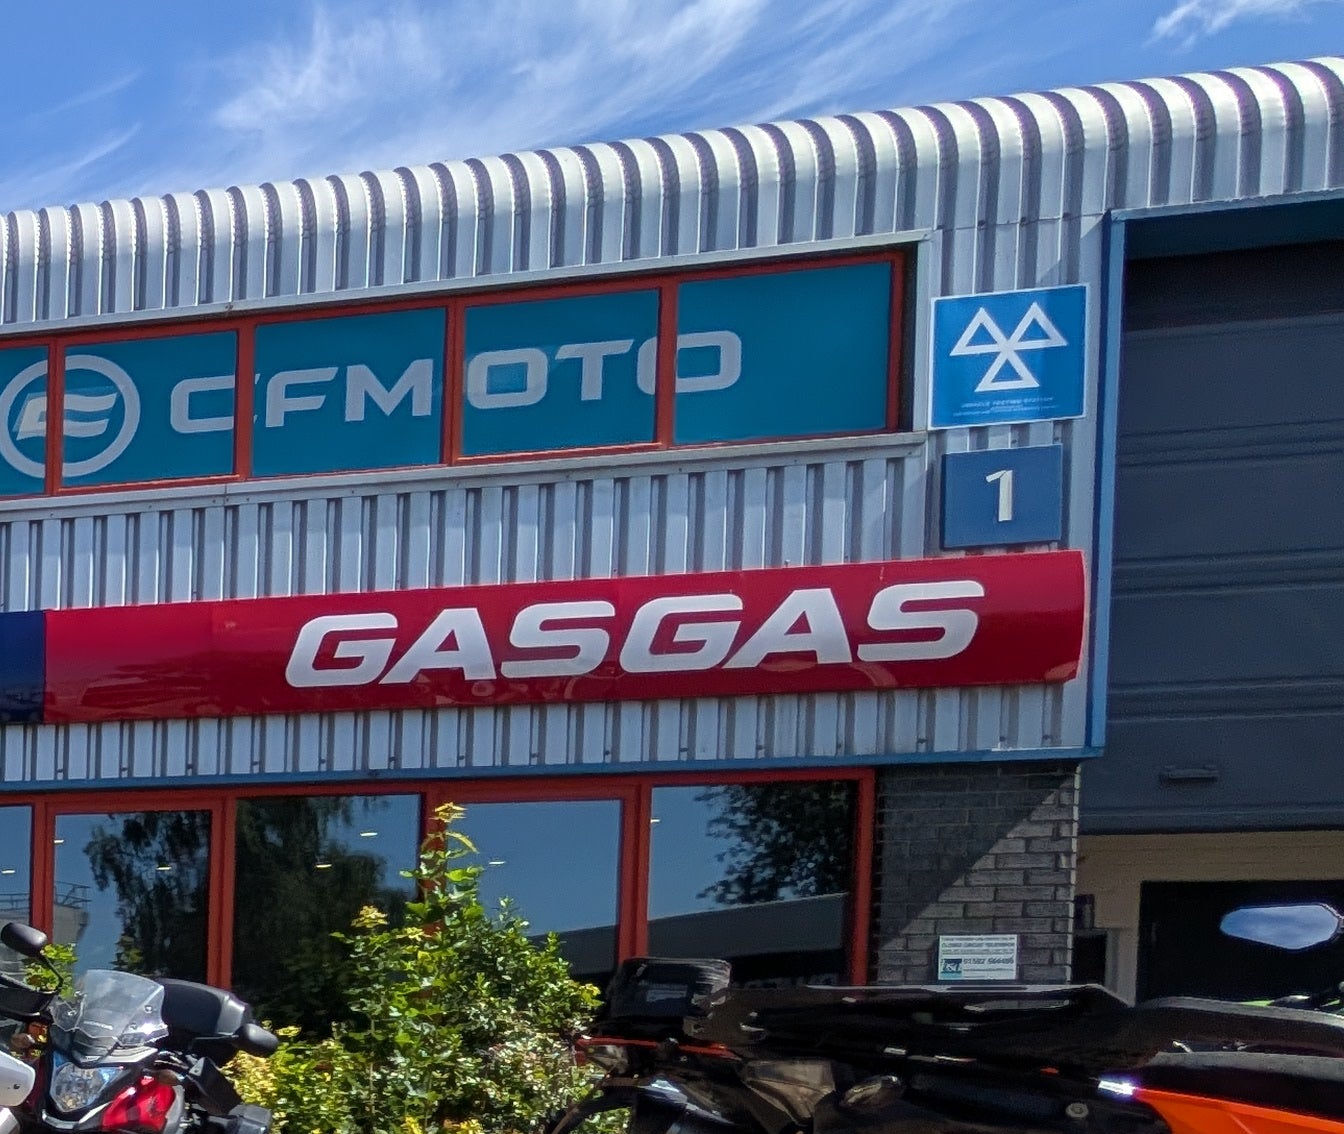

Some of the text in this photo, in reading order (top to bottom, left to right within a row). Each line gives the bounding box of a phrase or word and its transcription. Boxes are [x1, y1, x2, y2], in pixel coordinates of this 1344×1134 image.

[170, 330, 742, 434] CFMOTO
[985, 469, 1013, 522] 1
[285, 580, 985, 687] GASGAS
